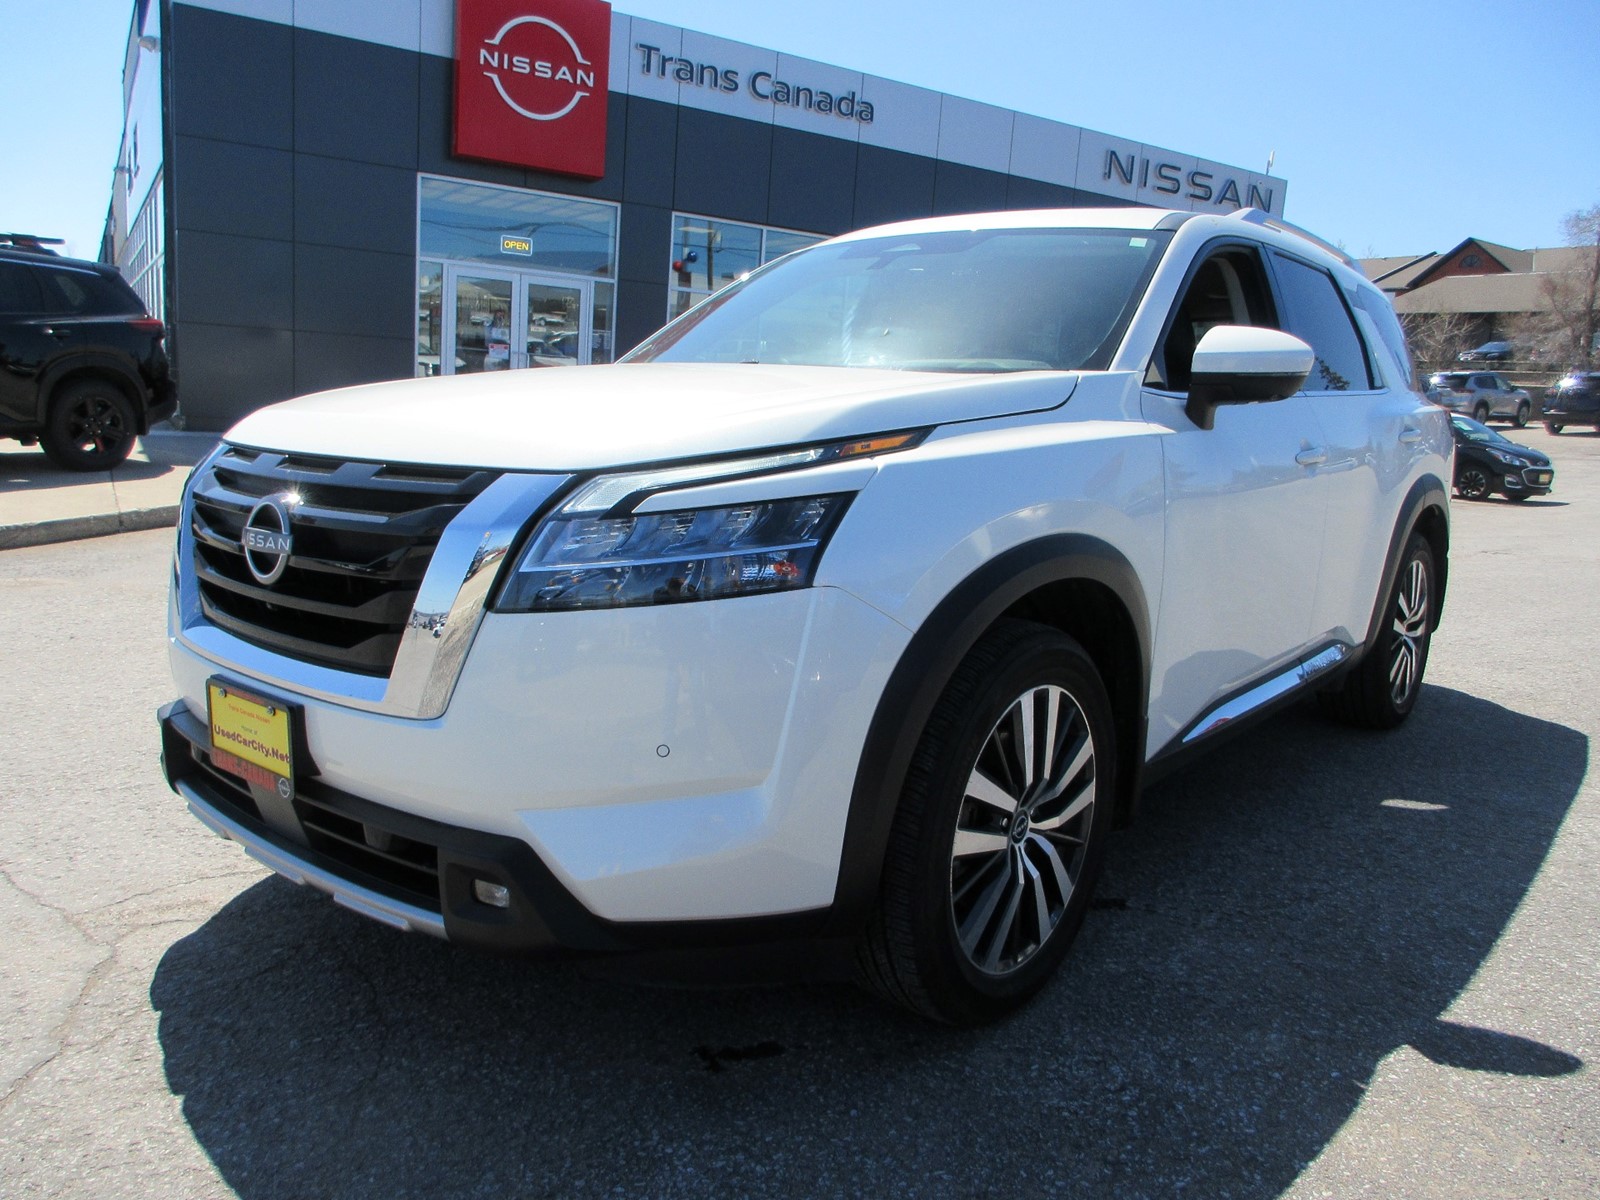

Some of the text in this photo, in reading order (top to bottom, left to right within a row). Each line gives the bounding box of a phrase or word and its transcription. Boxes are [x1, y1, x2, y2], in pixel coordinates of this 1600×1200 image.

[479, 48, 594, 88] NISSAN
[637, 43, 875, 124] Trans Canada
[1104, 150, 1273, 213] NISSAN
[504, 240, 529, 251] OPEN
[214, 724, 290, 763] UsedCarCity.Net
